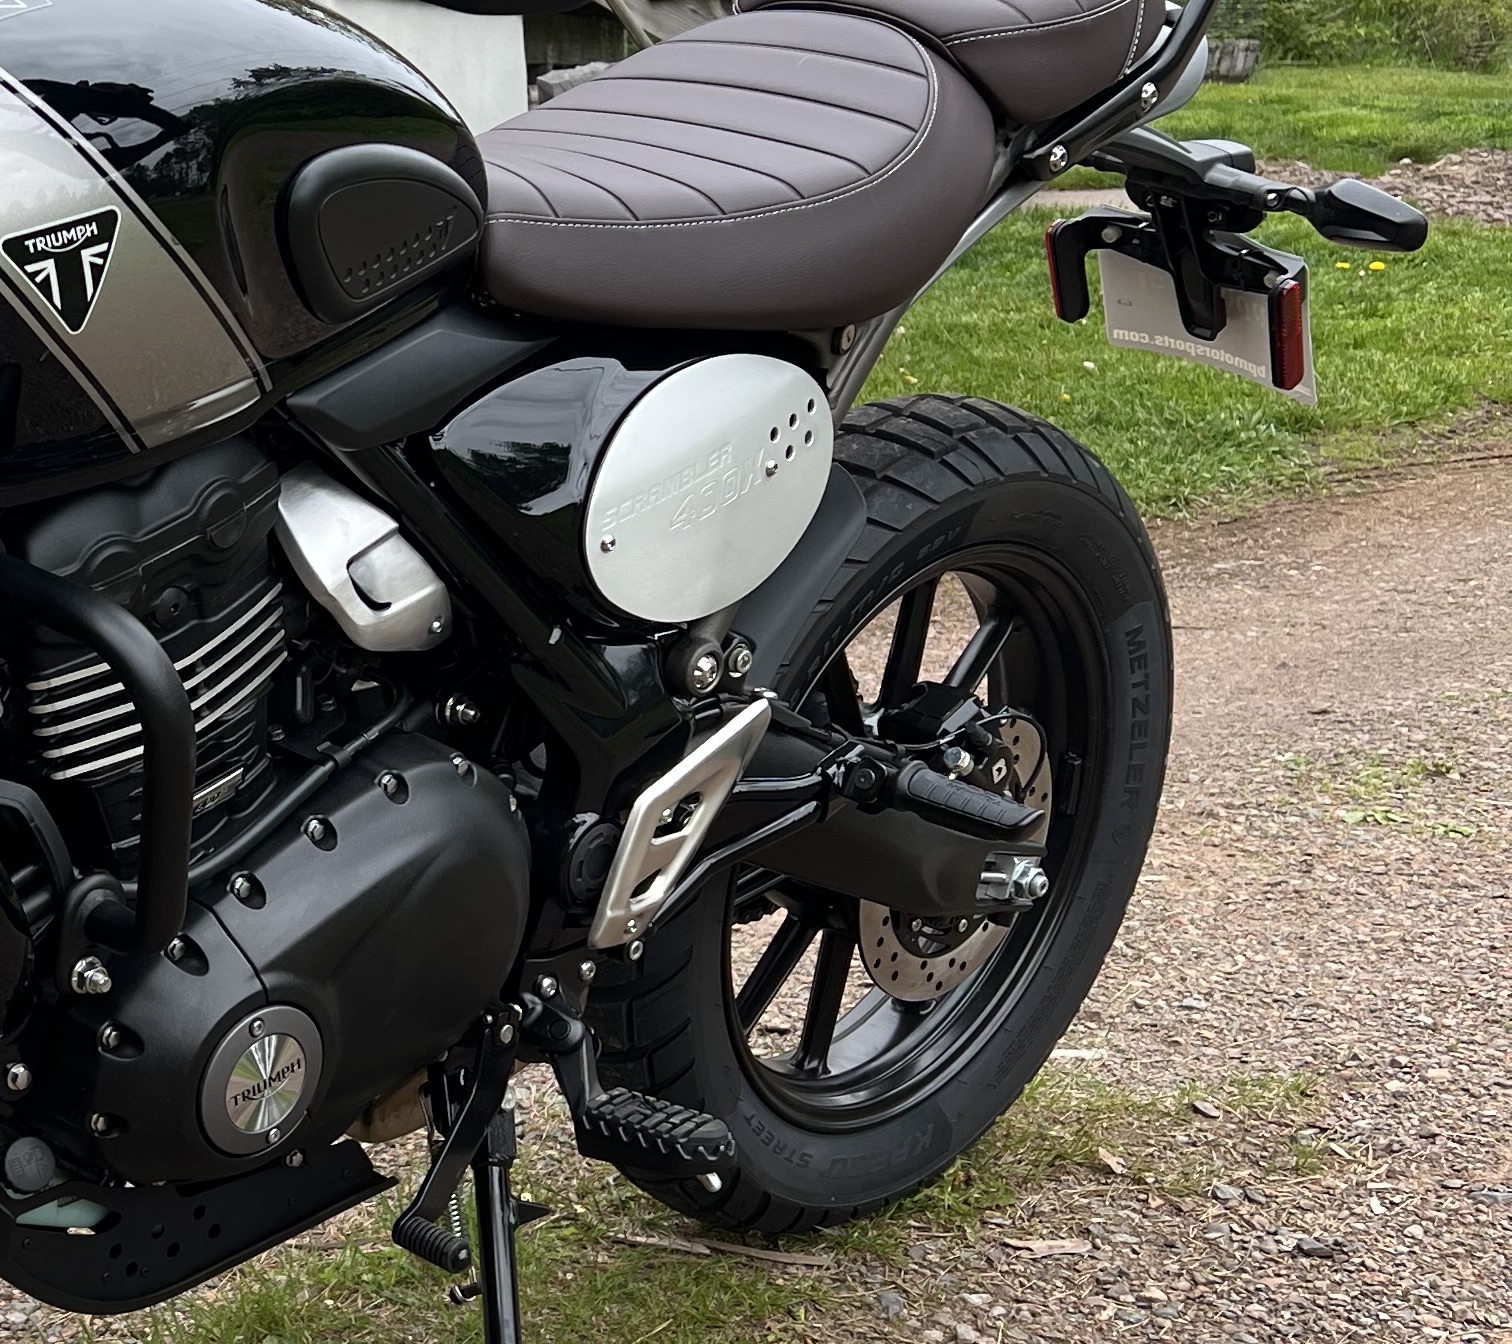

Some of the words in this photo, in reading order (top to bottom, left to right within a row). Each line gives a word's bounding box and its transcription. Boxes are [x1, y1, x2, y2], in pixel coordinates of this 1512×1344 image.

[24, 221, 98, 254] TRIUMPH
[601, 441, 732, 532] SCRAMBLER
[1121, 624, 1152, 810] METZELER
[229, 1057, 302, 1107] TRIUMPH
[743, 1112, 813, 1169] STREET
